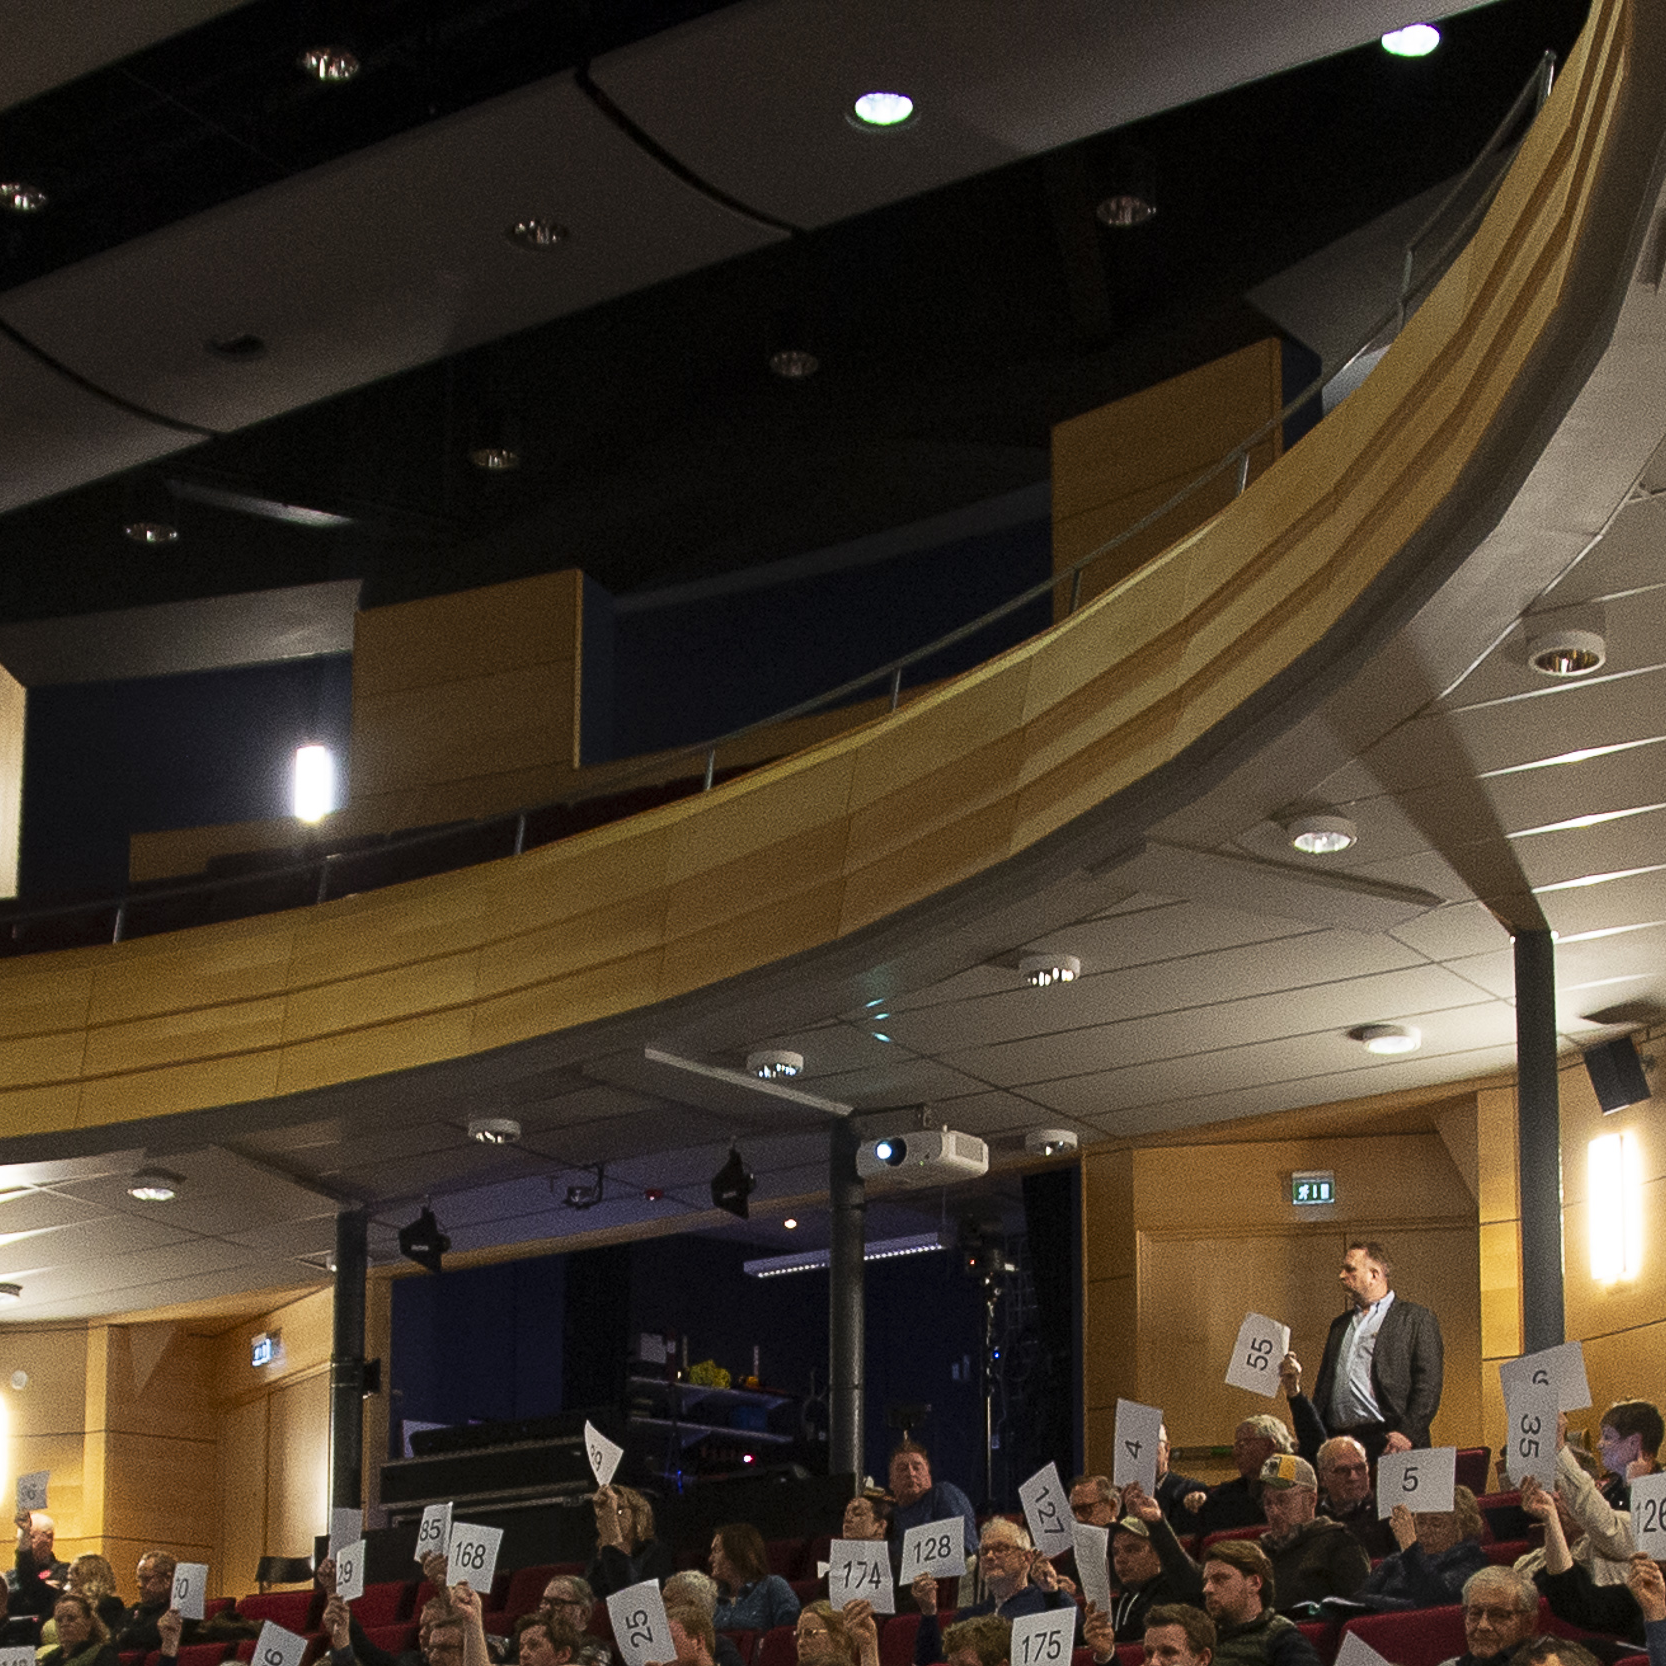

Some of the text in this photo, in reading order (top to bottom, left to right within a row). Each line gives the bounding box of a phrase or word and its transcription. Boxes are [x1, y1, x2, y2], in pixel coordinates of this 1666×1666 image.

[1247, 1337, 1273, 1371] 55
[1125, 1438, 1143, 1459] 4
[1519, 1413, 1541, 1459] 35
[1402, 1467, 1419, 1492] 5
[1035, 1488, 1064, 1534] 127
[454, 1541, 487, 1570] 168
[913, 1534, 952, 1564] 128
[842, 1560, 882, 1589] 174
[625, 1609, 653, 1648] 25
[1022, 1630, 1062, 1663] 175
